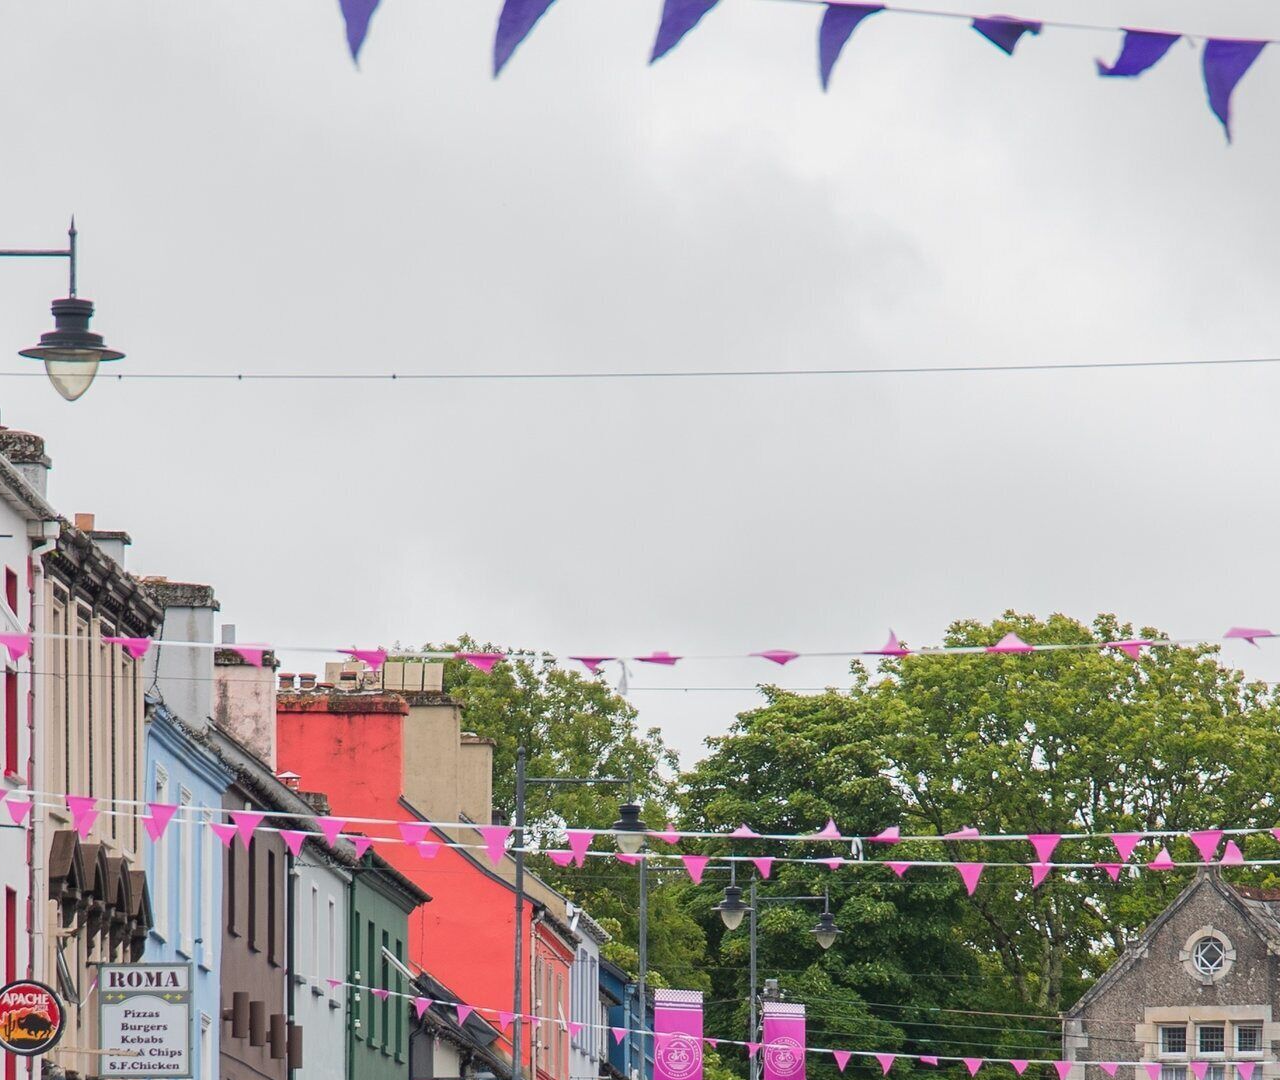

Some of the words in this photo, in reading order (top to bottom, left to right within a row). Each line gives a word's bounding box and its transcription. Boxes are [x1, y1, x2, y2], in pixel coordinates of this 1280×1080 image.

[109, 970, 180, 989] ROMA
[3, 993, 50, 1006] APACHE
[123, 1009, 161, 1019] Pizzas
[121, 1022, 168, 1033] Burgers
[121, 1035, 164, 1044] Kebabs
[149, 1047, 182, 1058] Chips
[109, 1061, 180, 1070] S.F.Chicken
